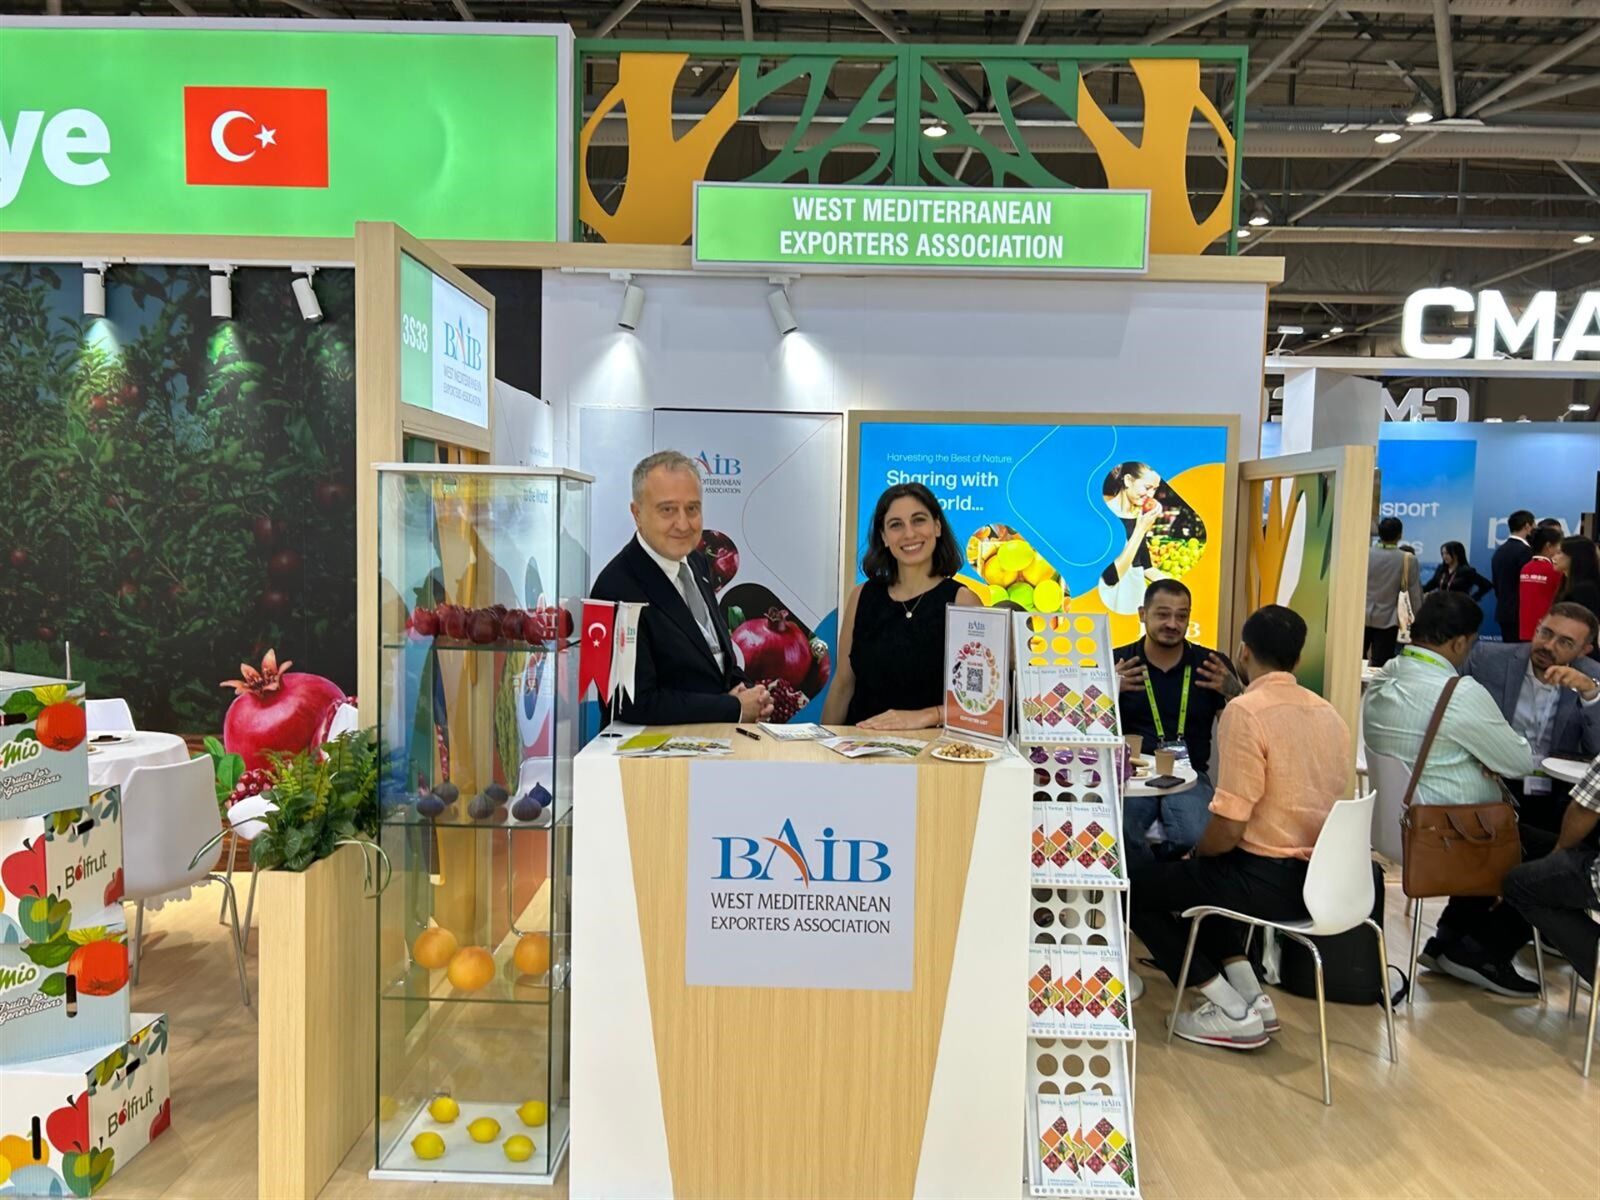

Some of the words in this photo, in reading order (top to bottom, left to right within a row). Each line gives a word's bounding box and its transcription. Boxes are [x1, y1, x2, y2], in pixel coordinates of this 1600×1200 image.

[792, 197, 856, 221] WEST
[863, 199, 1052, 225] MEDITERRANEAN
[780, 230, 909, 256] EXPORTERS
[916, 233, 1063, 259] ASSOCIATION
[402, 314, 429, 354] 3S33
[887, 453, 934, 464] Harvesting
[935, 454, 948, 463] the
[950, 454, 971, 463] Best
[972, 454, 981, 463] of
[886, 470, 957, 490] Sharing
[961, 472, 999, 487] with
[1, 741, 39, 768] Mio
[711, 892, 754, 910] WEST
[757, 893, 891, 913] MEDITERRANEAN
[711, 916, 790, 931] EXPORTERS
[793, 918, 890, 934] ASSOCIATION
